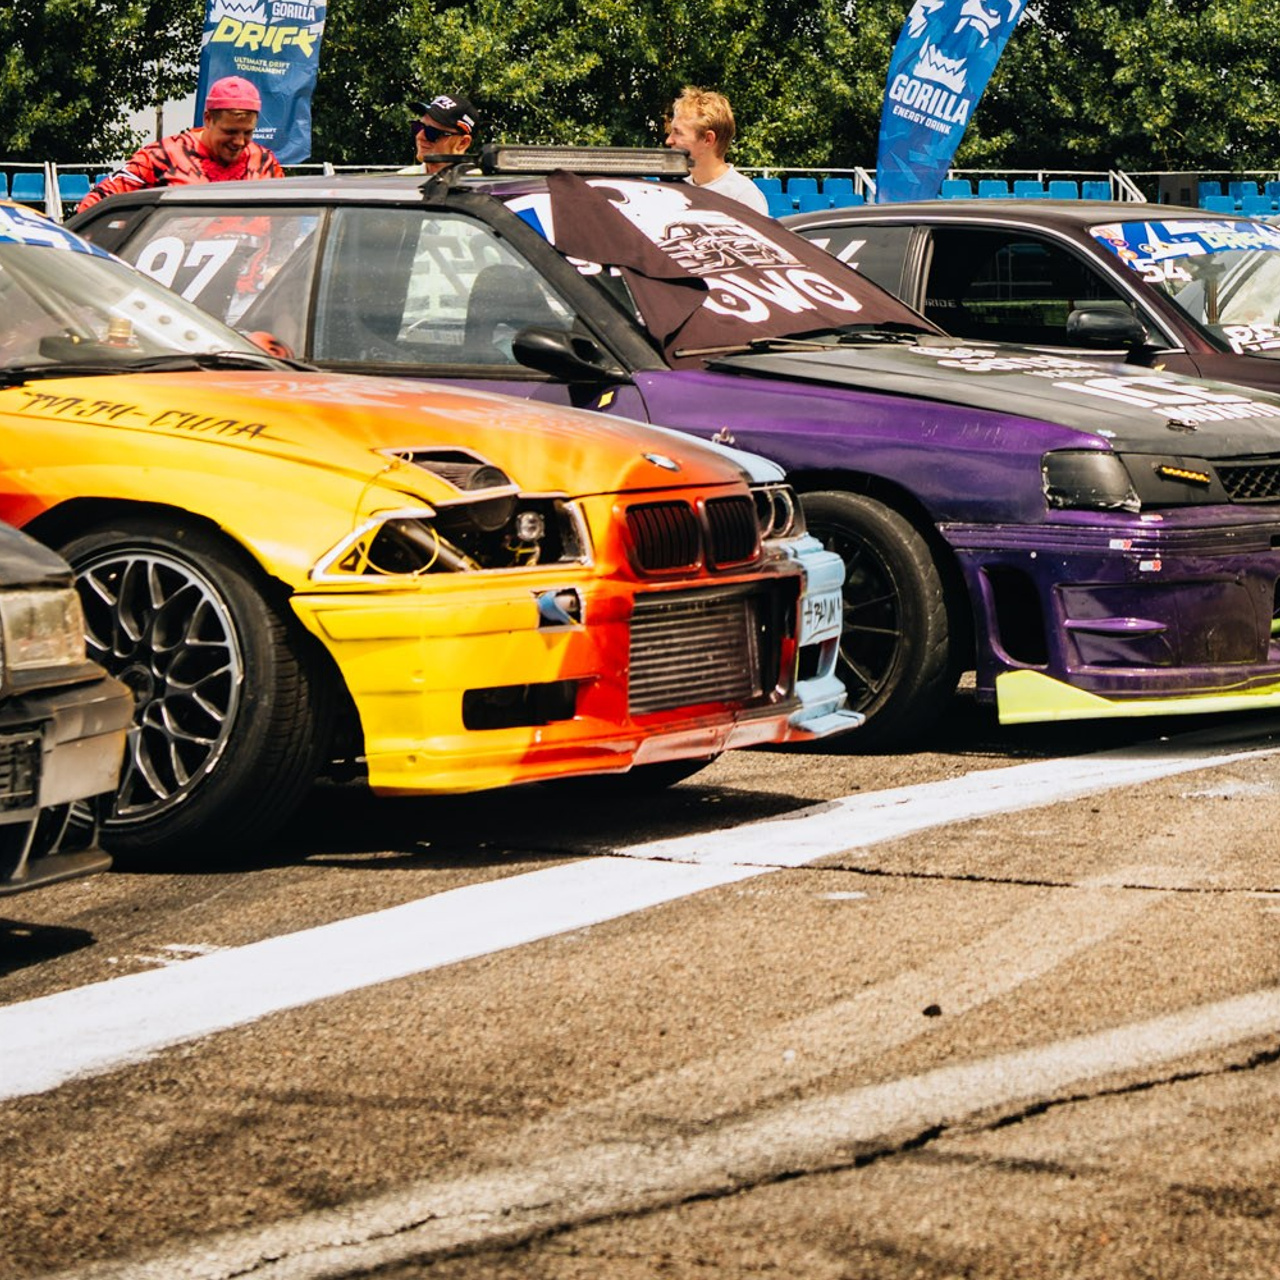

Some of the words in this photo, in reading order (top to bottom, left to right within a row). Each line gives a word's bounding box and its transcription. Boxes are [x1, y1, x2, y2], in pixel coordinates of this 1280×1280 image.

[272, 1, 315, 21] GORILLA
[211, 17, 318, 58] DRIFT
[234, 56, 267, 67] ULTIMATE
[268, 60, 290, 70] DRIFT
[236, 64, 287, 75] TOURNAMENT
[889, 74, 970, 126] GORILLA
[892, 104, 926, 125] ENERGY
[925, 117, 952, 134] DRINK
[1137, 258, 1193, 283] 54
[1051, 376, 1253, 408] ICE
